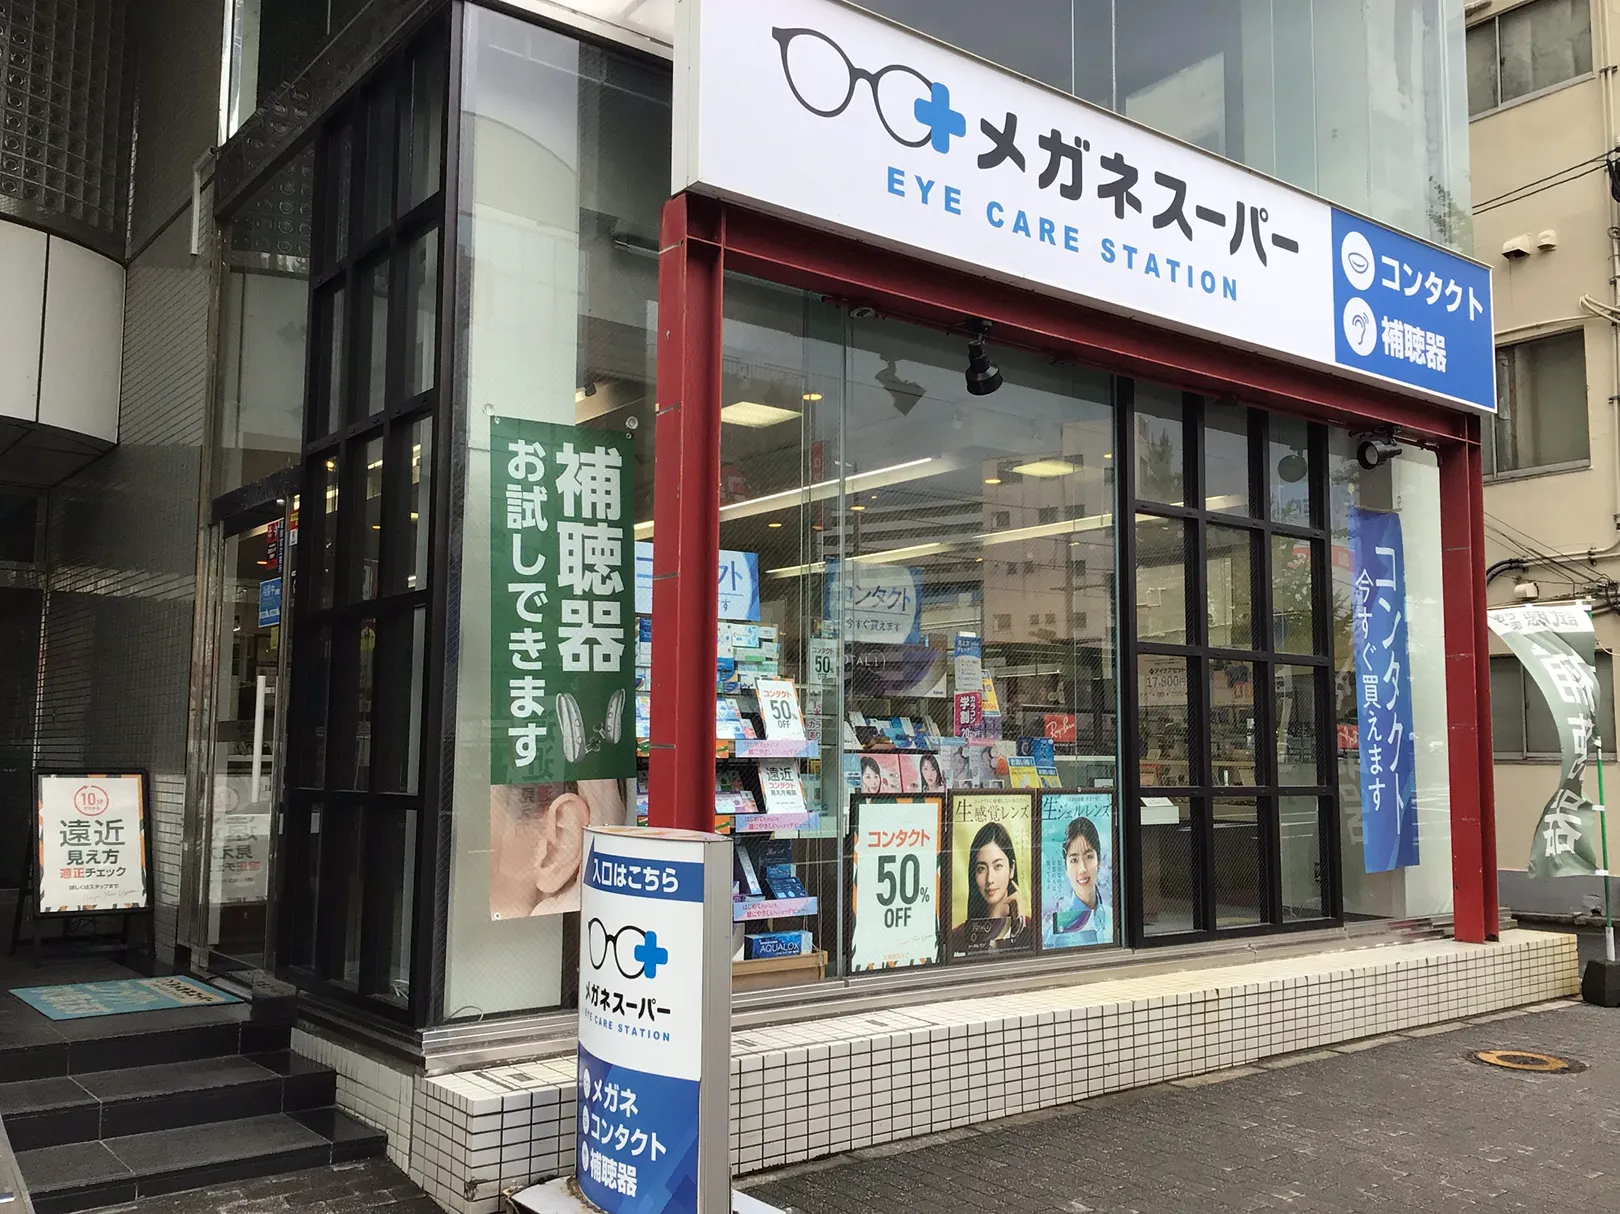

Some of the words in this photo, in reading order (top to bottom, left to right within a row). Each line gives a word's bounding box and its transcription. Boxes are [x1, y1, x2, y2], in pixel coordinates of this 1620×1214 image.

[976, 111, 1300, 268] メガネスーパー
[887, 165, 962, 216] EYE
[986, 201, 1080, 254] CARE
[1100, 238, 1238, 302] STATION
[1379, 254, 1485, 315] コンタクト
[1380, 315, 1448, 374] 補聴器
[555, 442, 625, 673] 補聴器
[505, 439, 547, 768] お試しできます
[1354, 567, 1386, 812] 今すぐ買えます
[1374, 546, 1404, 835] コンタクト
[777, 720, 791, 729] OFF
[765, 766, 794, 781] 遠近
[955, 798, 1030, 823] 生感覚レンズ
[1041, 796, 1112, 821] 生ジェルレンズ
[59, 818, 126, 848] 遠近
[867, 829, 931, 848] コンタクト
[60, 866, 127, 880] 適正チェック
[66, 849, 120, 866] 見え方
[68, 883, 119, 891] 詳しくはスタッフまで
[592, 861, 680, 894] 入口はこちら
[884, 907, 912, 929] OFF
[759, 941, 800, 953] AQUALOX
[585, 981, 671, 1022] メガネスーパー
[595, 1014, 613, 1030] CARE
[617, 1023, 670, 1042] STATION
[592, 1078, 639, 1117] メガネ
[590, 1113, 667, 1163] コンタクト
[590, 1147, 638, 1198] 補聴器
